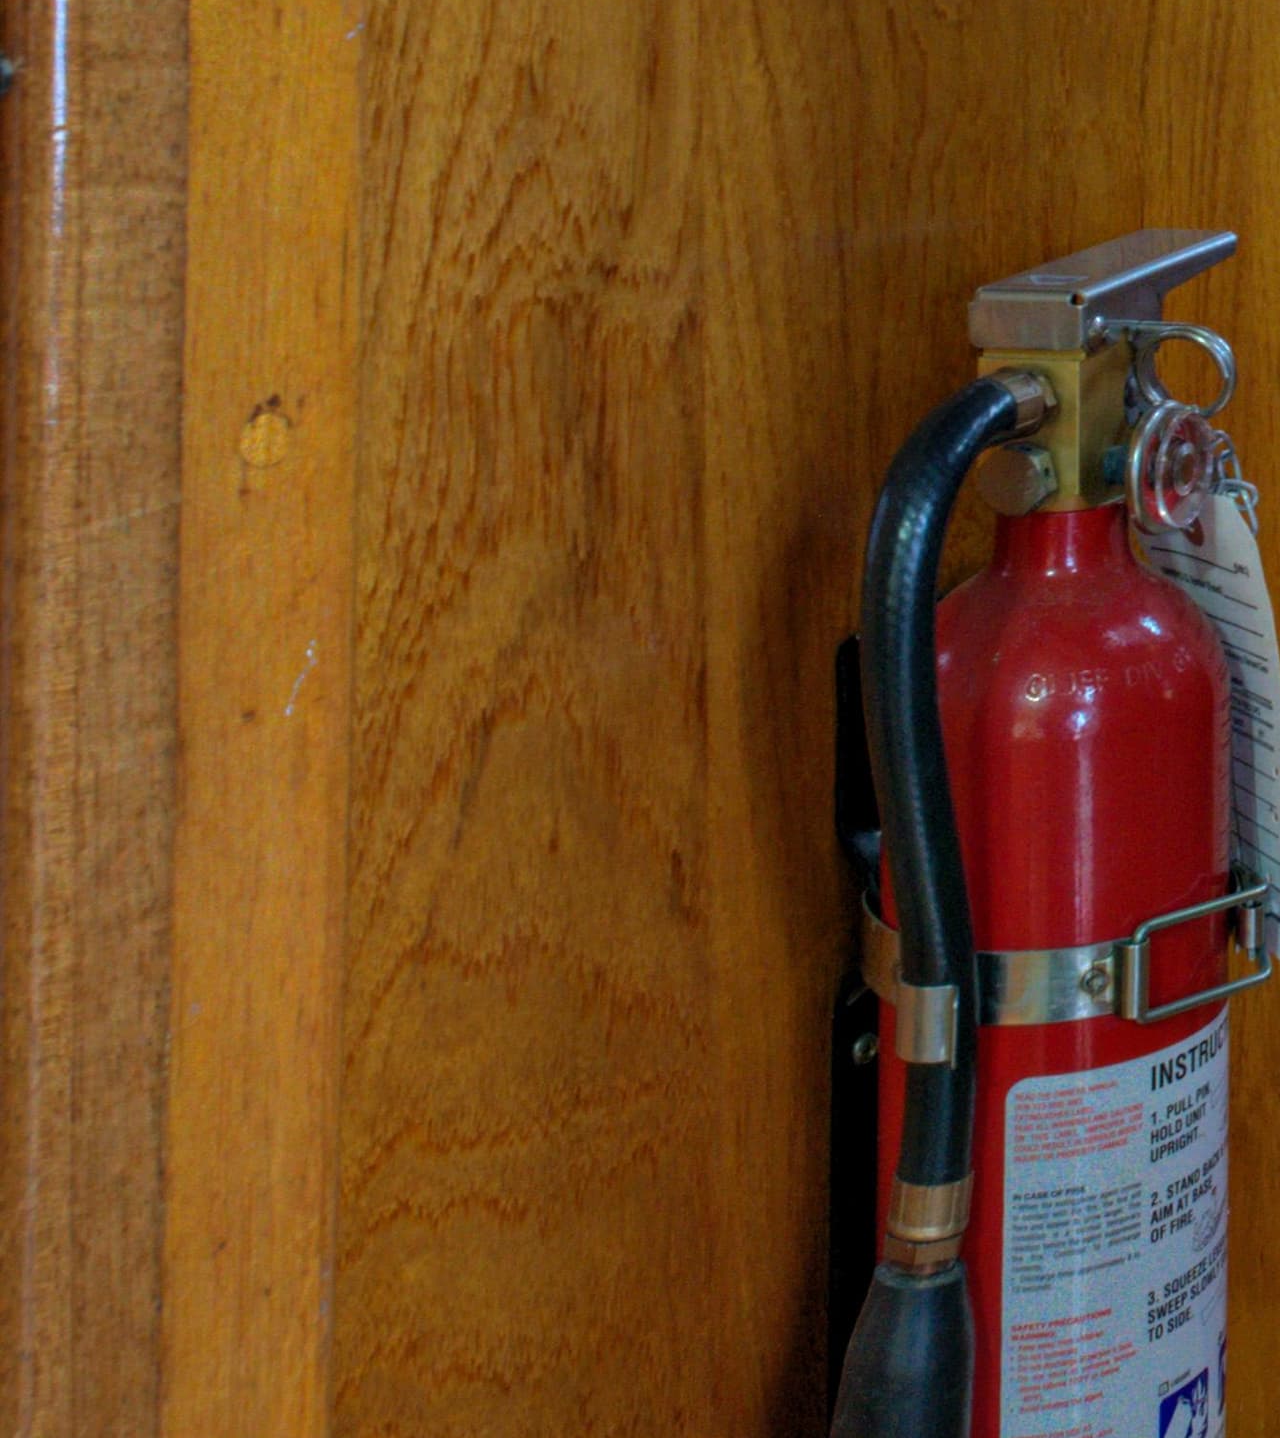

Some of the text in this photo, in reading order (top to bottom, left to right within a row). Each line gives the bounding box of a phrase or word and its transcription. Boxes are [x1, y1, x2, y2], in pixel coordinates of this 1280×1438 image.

[1150, 1102, 1207, 1145] HOLD UNIT
[1166, 1095, 1194, 1119] PULL
[1150, 1174, 1213, 1225] AIM AT BASE
[1166, 1167, 1201, 1201] STAND
[1150, 1225, 1167, 1244] OF
[1163, 1256, 1208, 1299] SQUEEZE
[1147, 1291, 1188, 1325] SWEEP
[1148, 1323, 1163, 1343] TO
